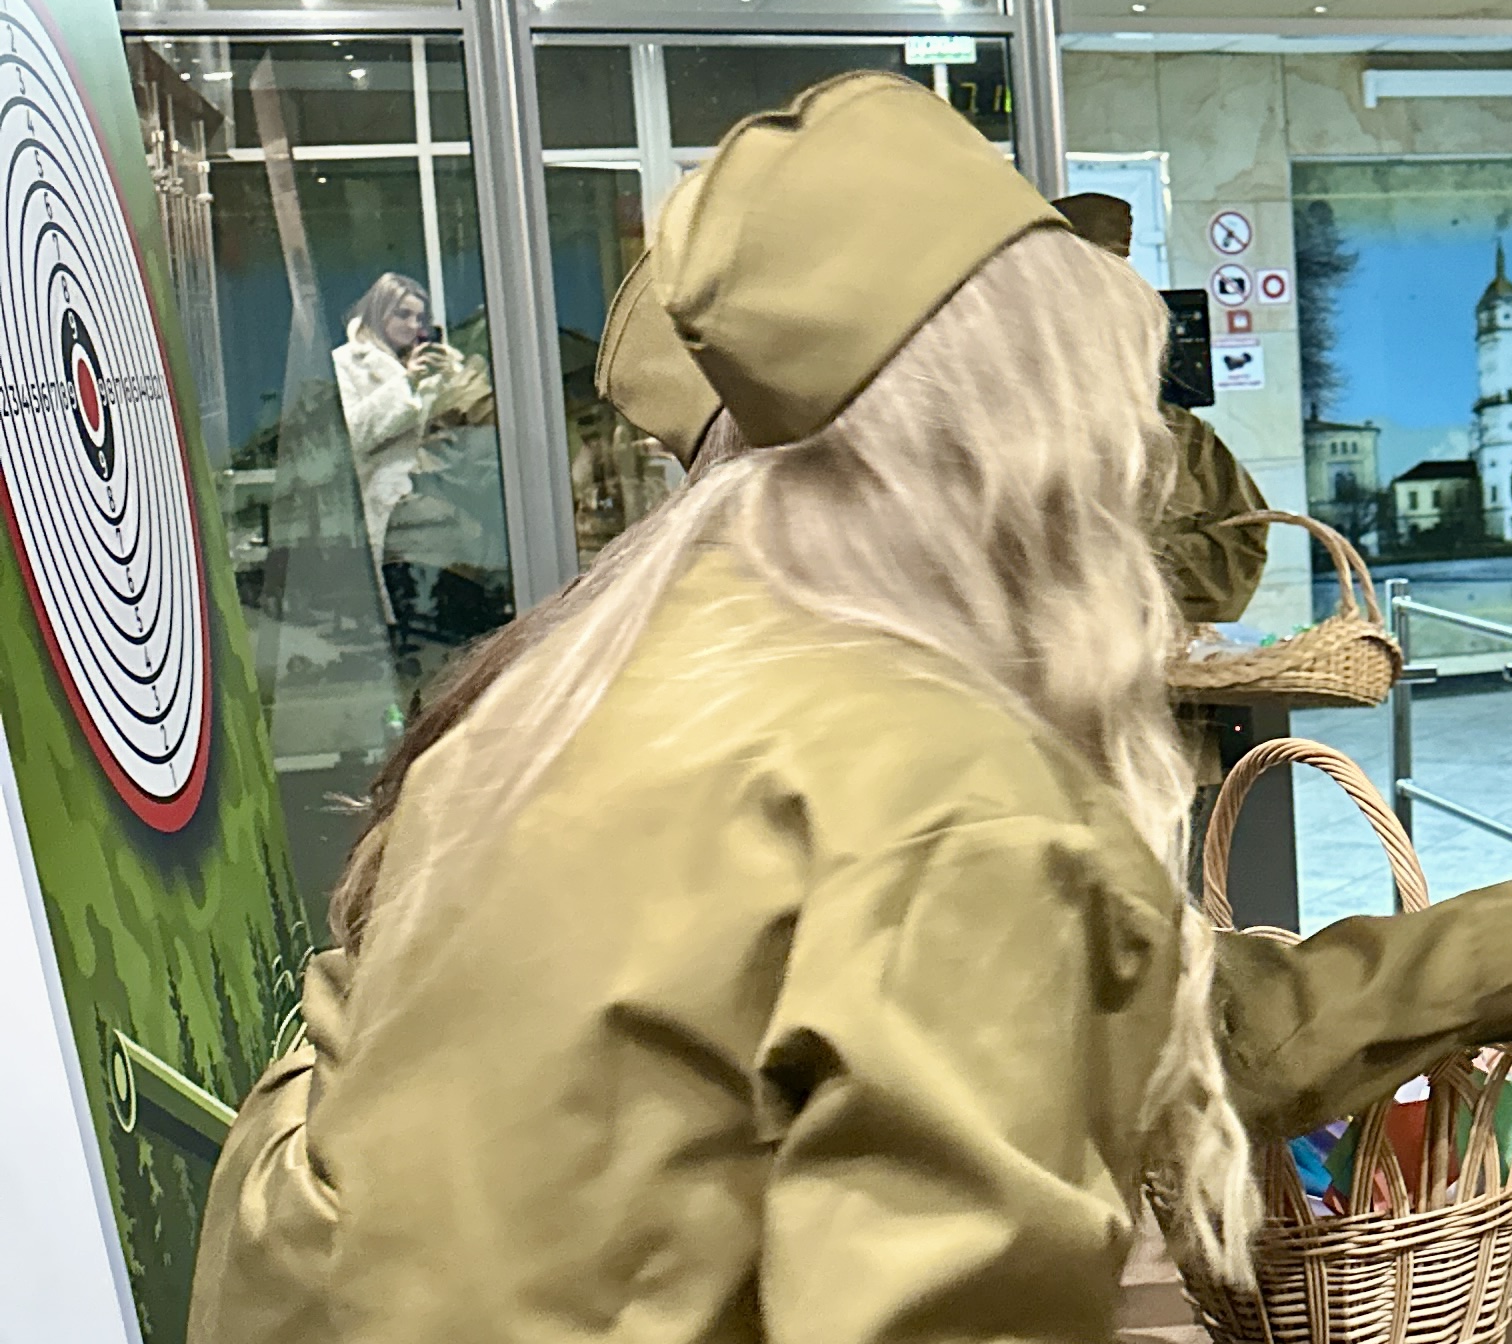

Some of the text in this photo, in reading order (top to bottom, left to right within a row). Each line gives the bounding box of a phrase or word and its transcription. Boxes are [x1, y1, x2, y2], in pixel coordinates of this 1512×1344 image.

[7, 24, 17, 53] 2
[16, 66, 26, 95] 3
[26, 109, 35, 136] 4
[34, 150, 44, 178] 5
[44, 192, 53, 220] 6
[52, 233, 61, 260] 7
[61, 275, 70, 303] 8
[68, 312, 78, 340] 9
[98, 450, 109, 479] 9
